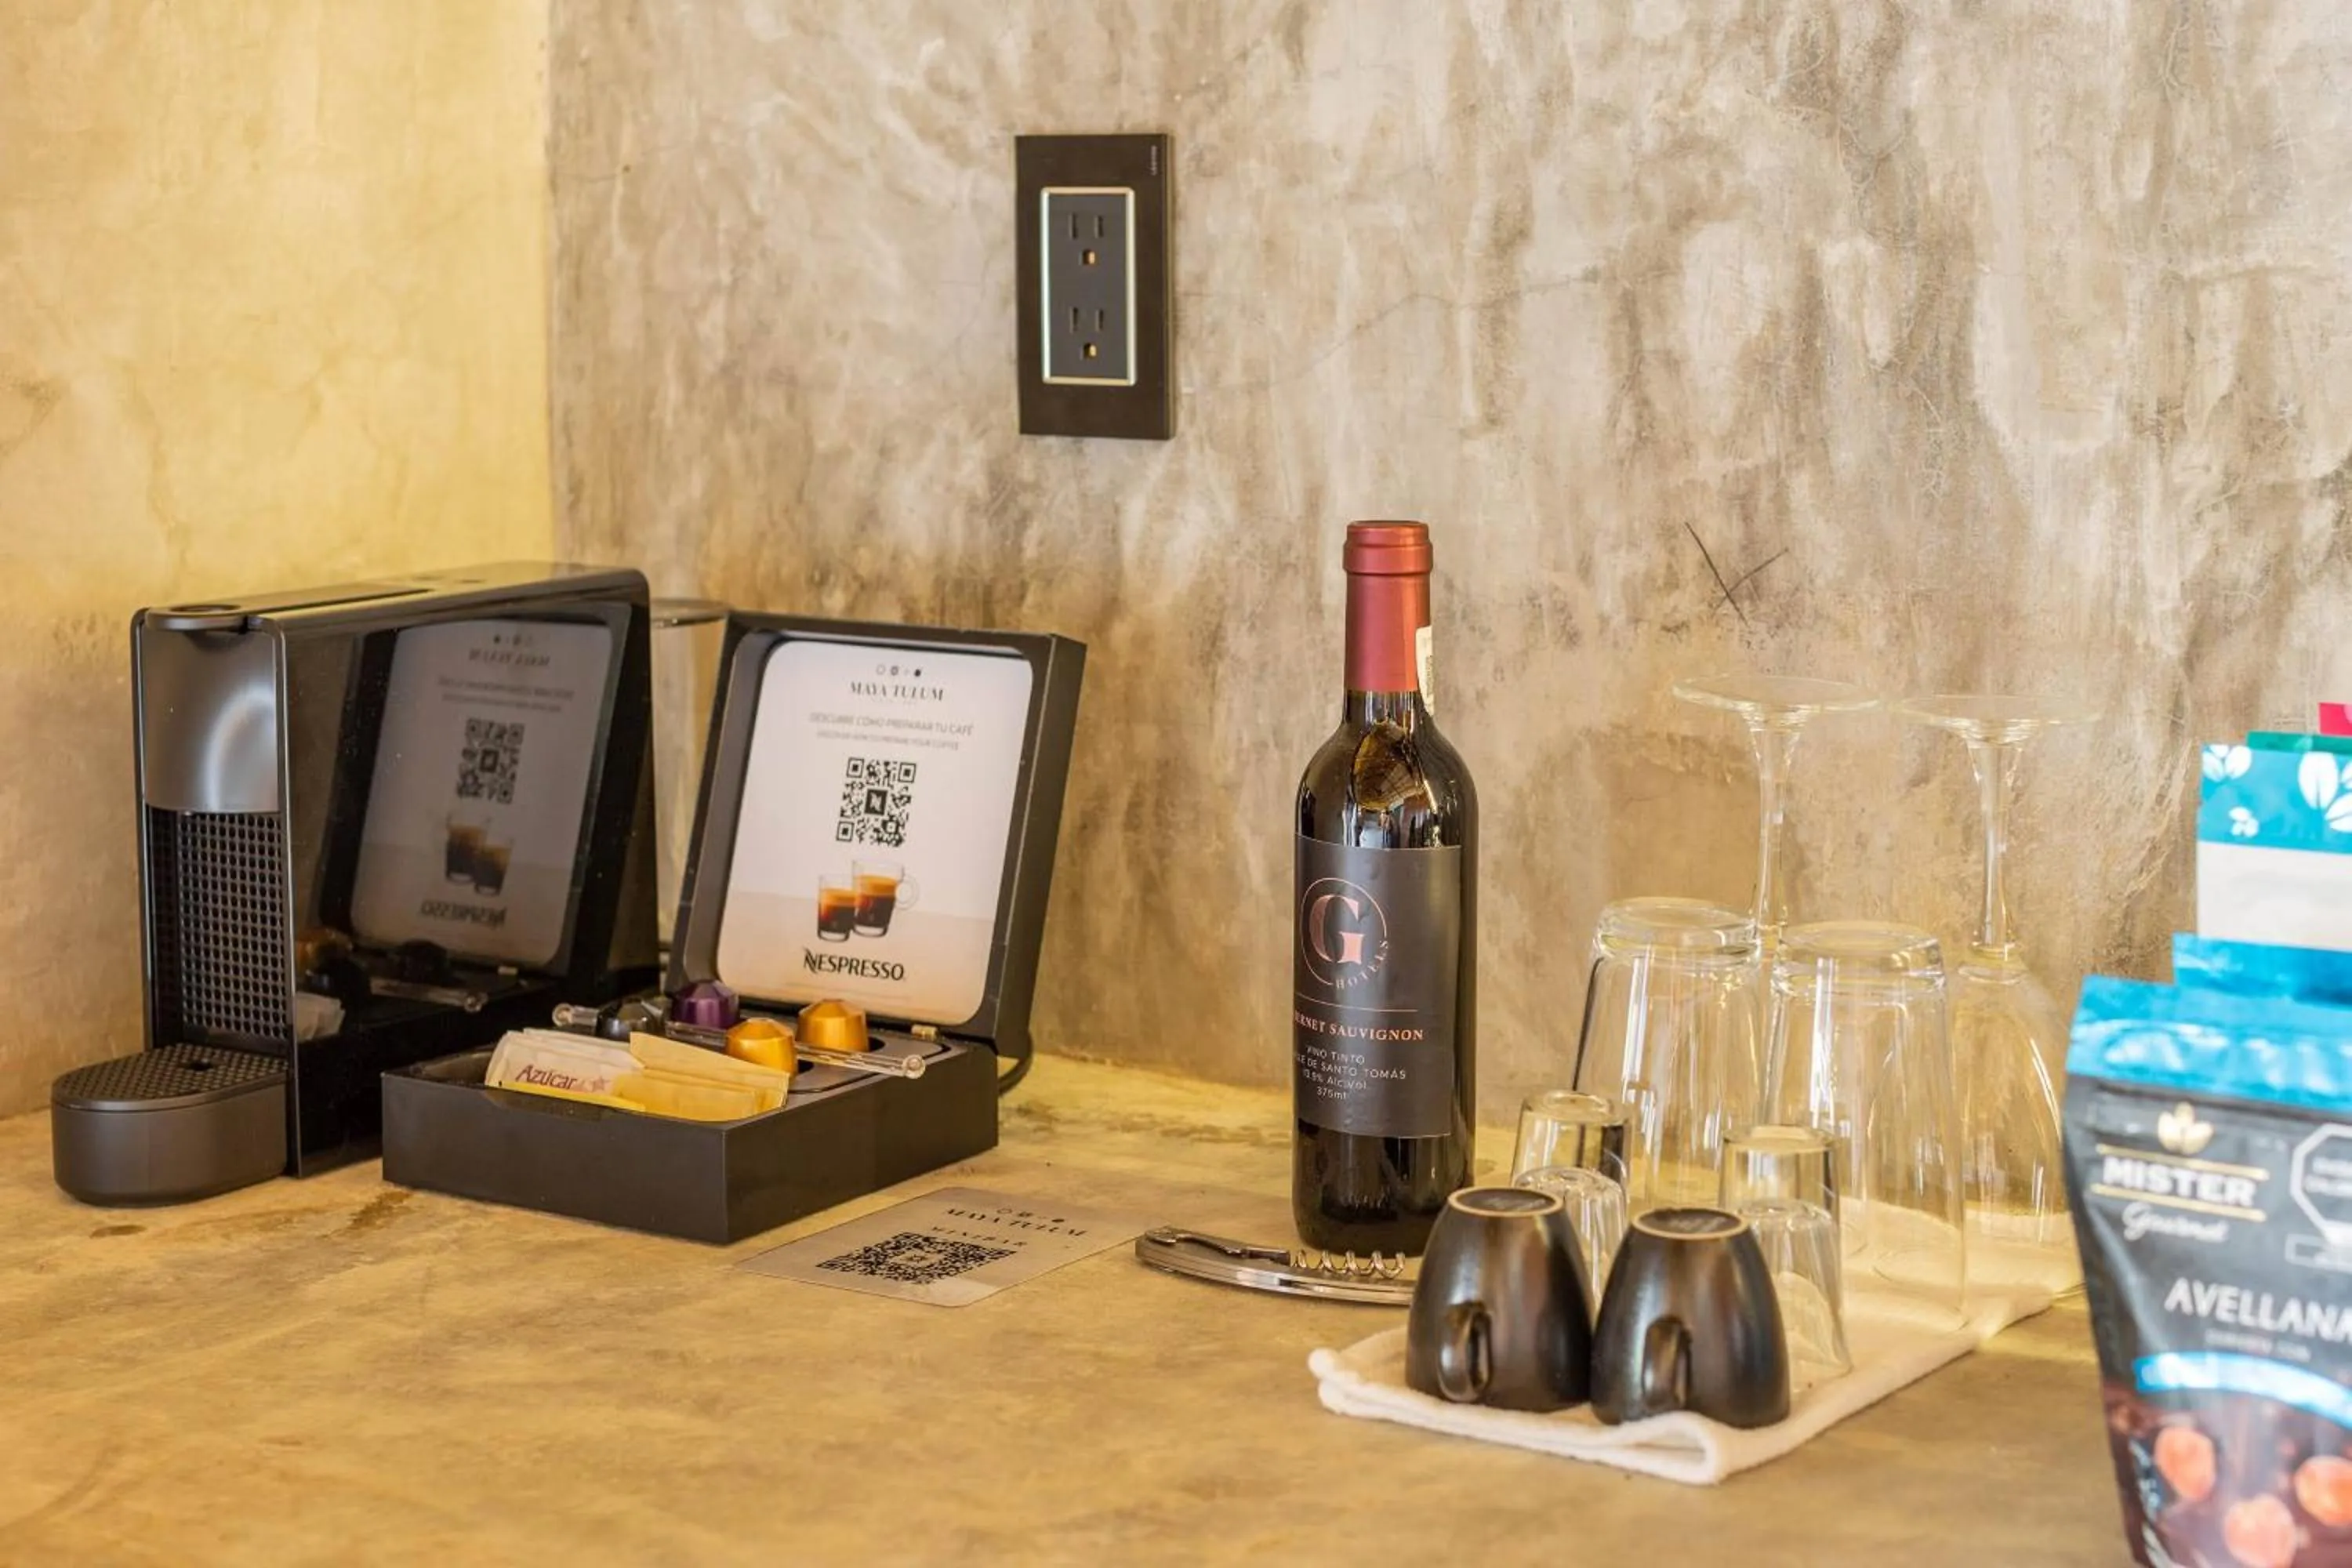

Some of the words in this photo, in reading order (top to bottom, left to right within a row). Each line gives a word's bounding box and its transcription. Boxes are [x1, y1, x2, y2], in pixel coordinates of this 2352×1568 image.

[1308, 893, 1365, 966] G
[803, 946, 905, 981] NESPRESSO
[1329, 1023, 1424, 1040] SAUVIGNON
[1321, 1062, 1358, 1077] SANTO
[1331, 1051, 1365, 1065] TINTO
[2103, 1156, 2257, 1207] MISTER
